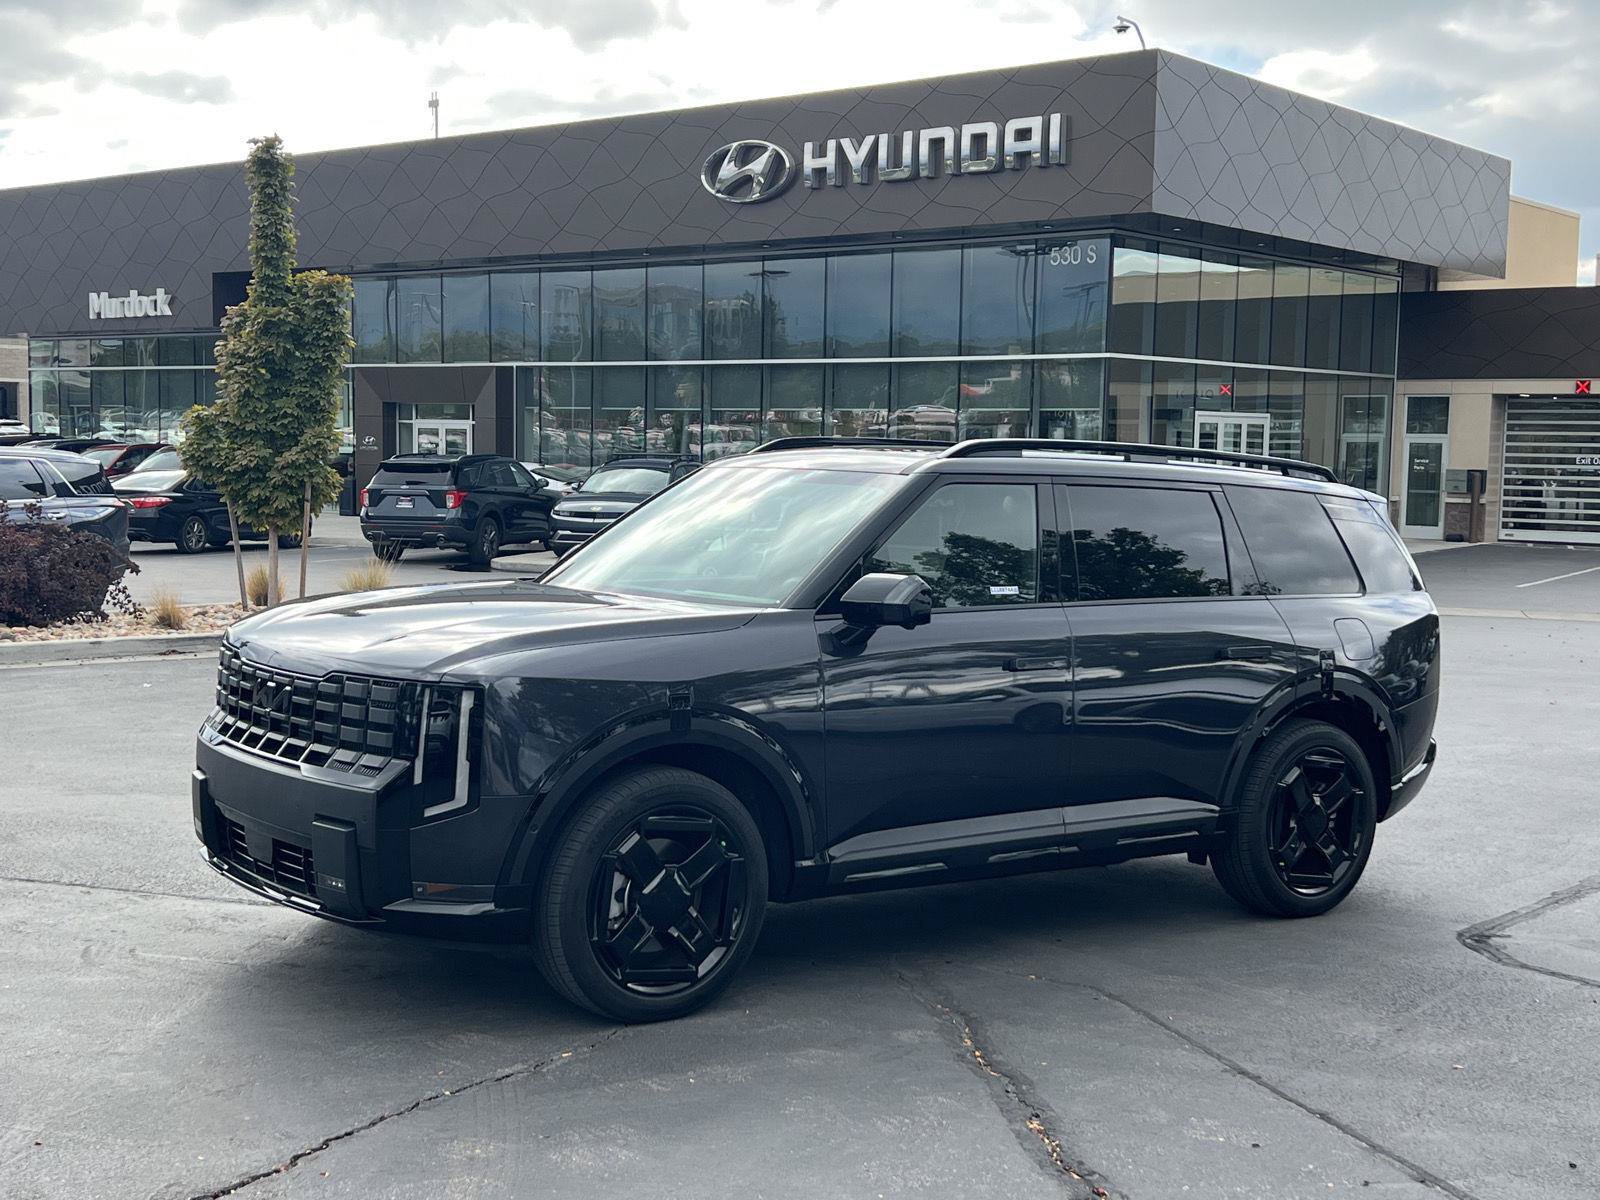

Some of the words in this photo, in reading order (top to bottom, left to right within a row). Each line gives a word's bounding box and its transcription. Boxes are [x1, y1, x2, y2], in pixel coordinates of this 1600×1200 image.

[803, 112, 1070, 189] HYUNDAI
[1050, 246, 1081, 266] 530
[1086, 244, 1097, 264] S
[88, 287, 173, 320] Murdock
[1575, 455, 1591, 465] Exit
